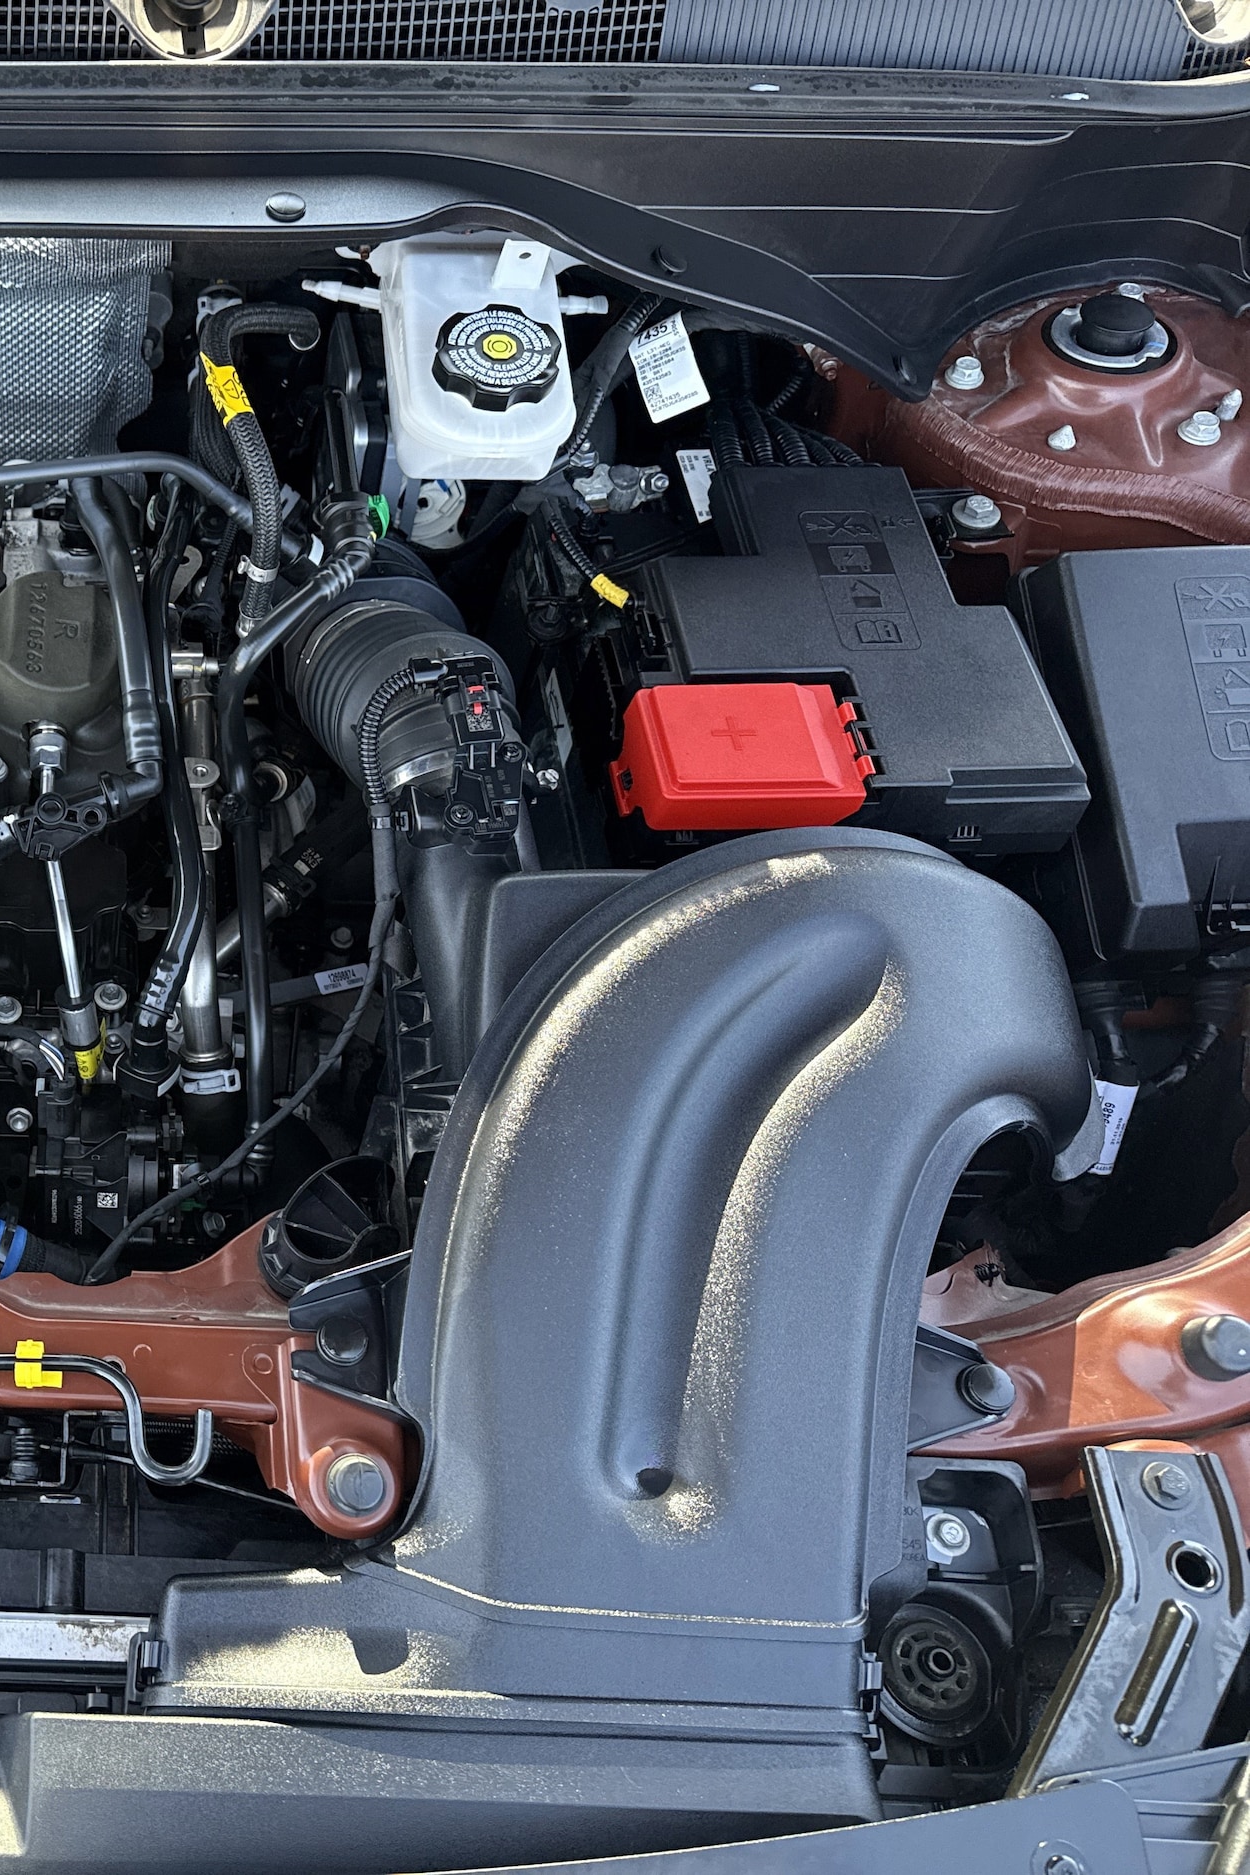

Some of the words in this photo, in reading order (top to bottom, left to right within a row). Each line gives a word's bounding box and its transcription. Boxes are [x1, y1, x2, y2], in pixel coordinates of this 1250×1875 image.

[637, 320, 668, 344] 7435
[493, 363, 517, 371] CLEAN
[473, 373, 496, 384] FROM
[501, 376, 528, 385] SEALED
[26, 581, 48, 673] 12670563
[54, 618, 80, 639] R
[301, 851, 319, 868] ENG
